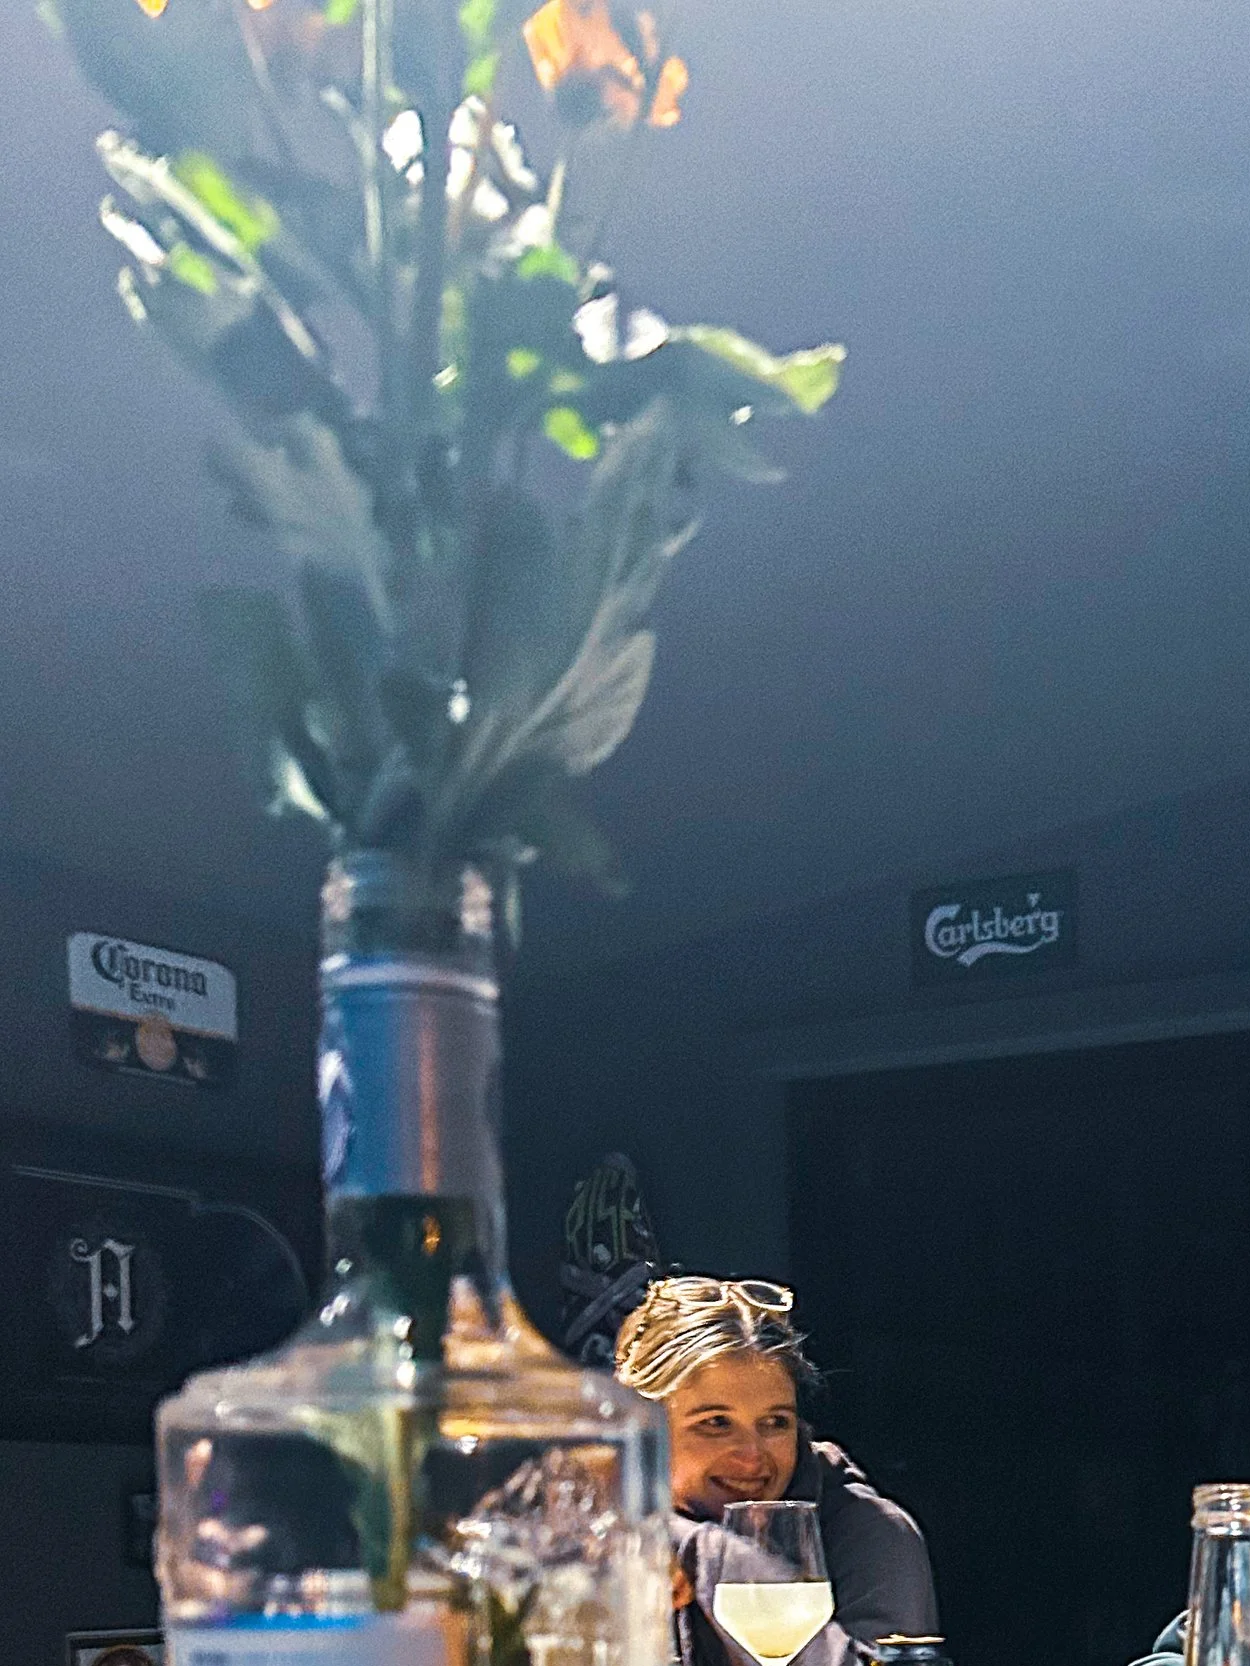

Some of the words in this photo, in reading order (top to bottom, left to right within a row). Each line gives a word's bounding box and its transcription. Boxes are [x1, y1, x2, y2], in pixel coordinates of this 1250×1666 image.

[924, 892, 1064, 967] Carlsberg
[91, 940, 208, 997] Corona
[129, 982, 177, 1010] Extra
